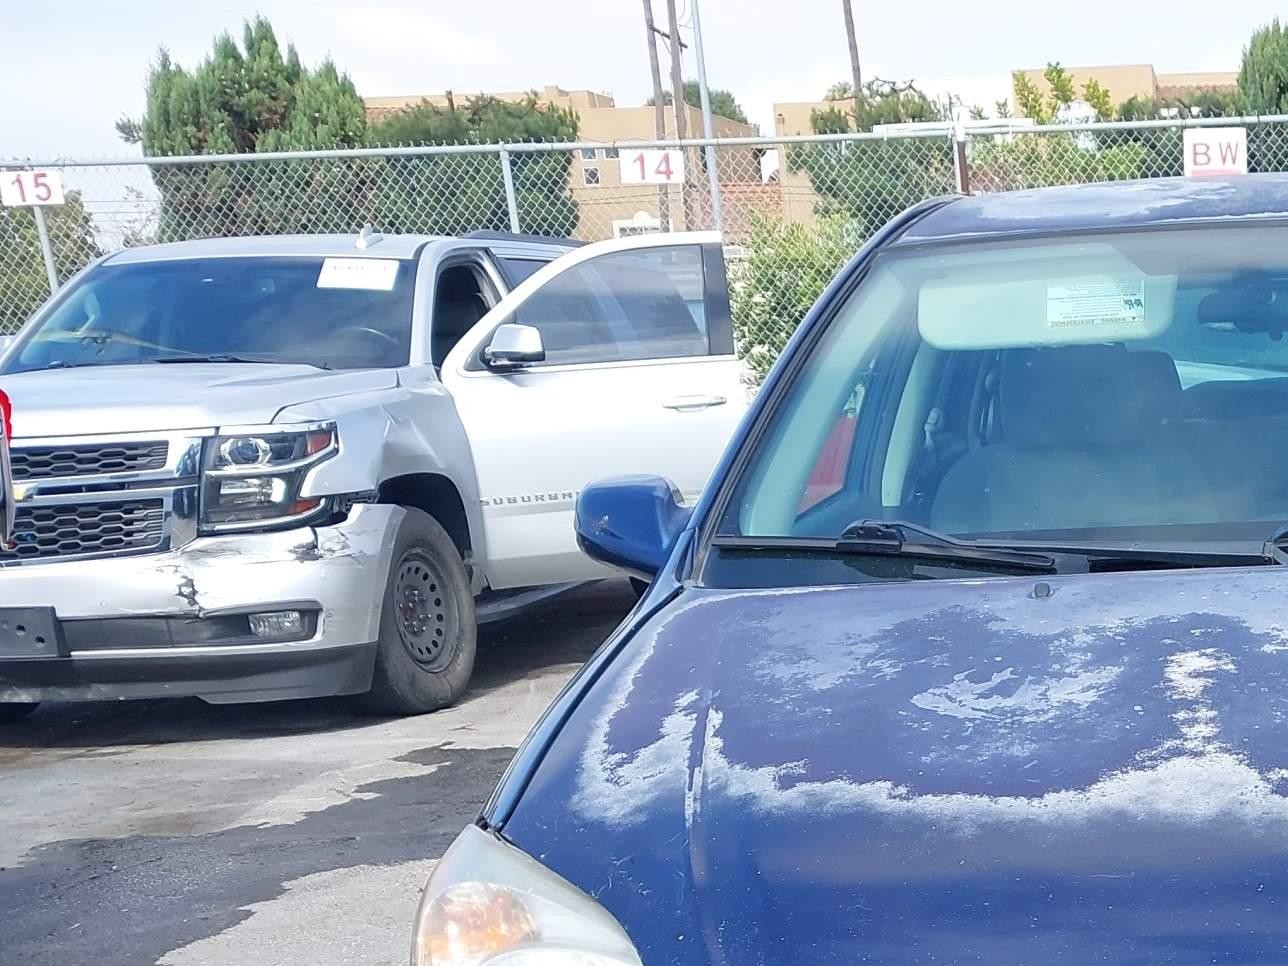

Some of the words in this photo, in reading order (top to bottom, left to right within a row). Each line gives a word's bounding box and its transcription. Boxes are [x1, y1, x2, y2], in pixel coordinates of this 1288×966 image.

[632, 151, 674, 181] 14
[11, 172, 53, 203] 15
[479, 490, 580, 506] SUBURBA
